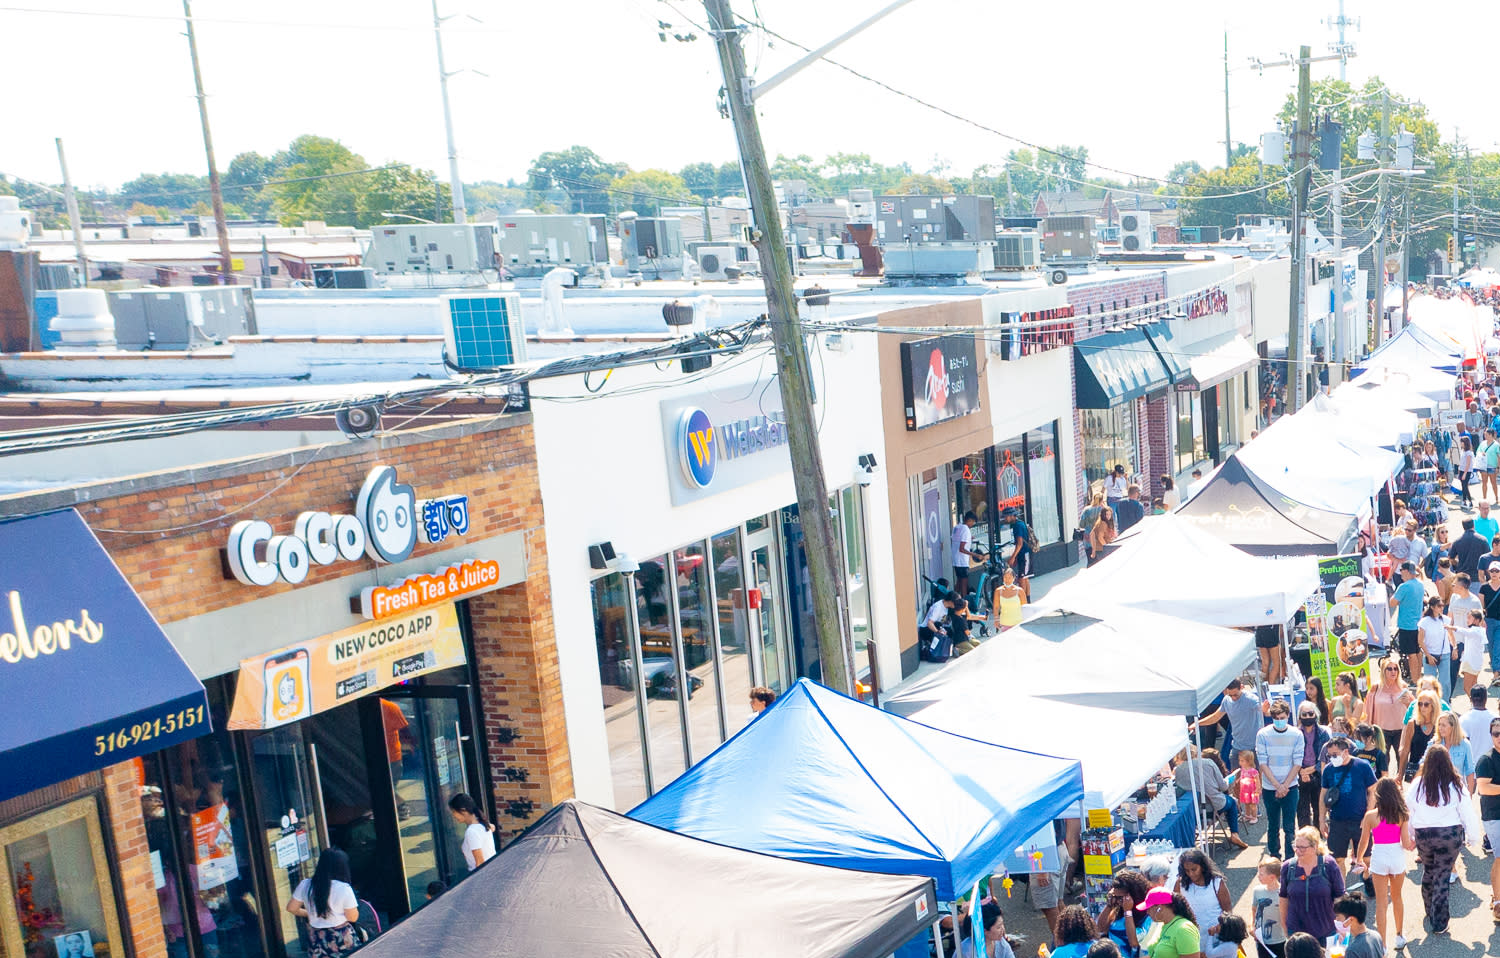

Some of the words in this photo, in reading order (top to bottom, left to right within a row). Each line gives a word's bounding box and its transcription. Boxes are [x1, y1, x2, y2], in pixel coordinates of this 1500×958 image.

[952, 375, 965, 394] sushi
[422, 495, 470, 544] 都可
[376, 582, 418, 616] Fresh
[420, 576, 446, 604] Tea
[448, 576, 459, 596] &
[460, 562, 497, 594] Juice
[1320, 564, 1358, 576] Prefusion
[0, 590, 104, 665] elers
[335, 635, 366, 661] NEW
[368, 623, 404, 649] COCO
[407, 615, 433, 636] APP
[1313, 657, 1339, 666] SERVCES
[1321, 662, 1341, 671] OFER
[95, 705, 204, 756] 516-921-5151
